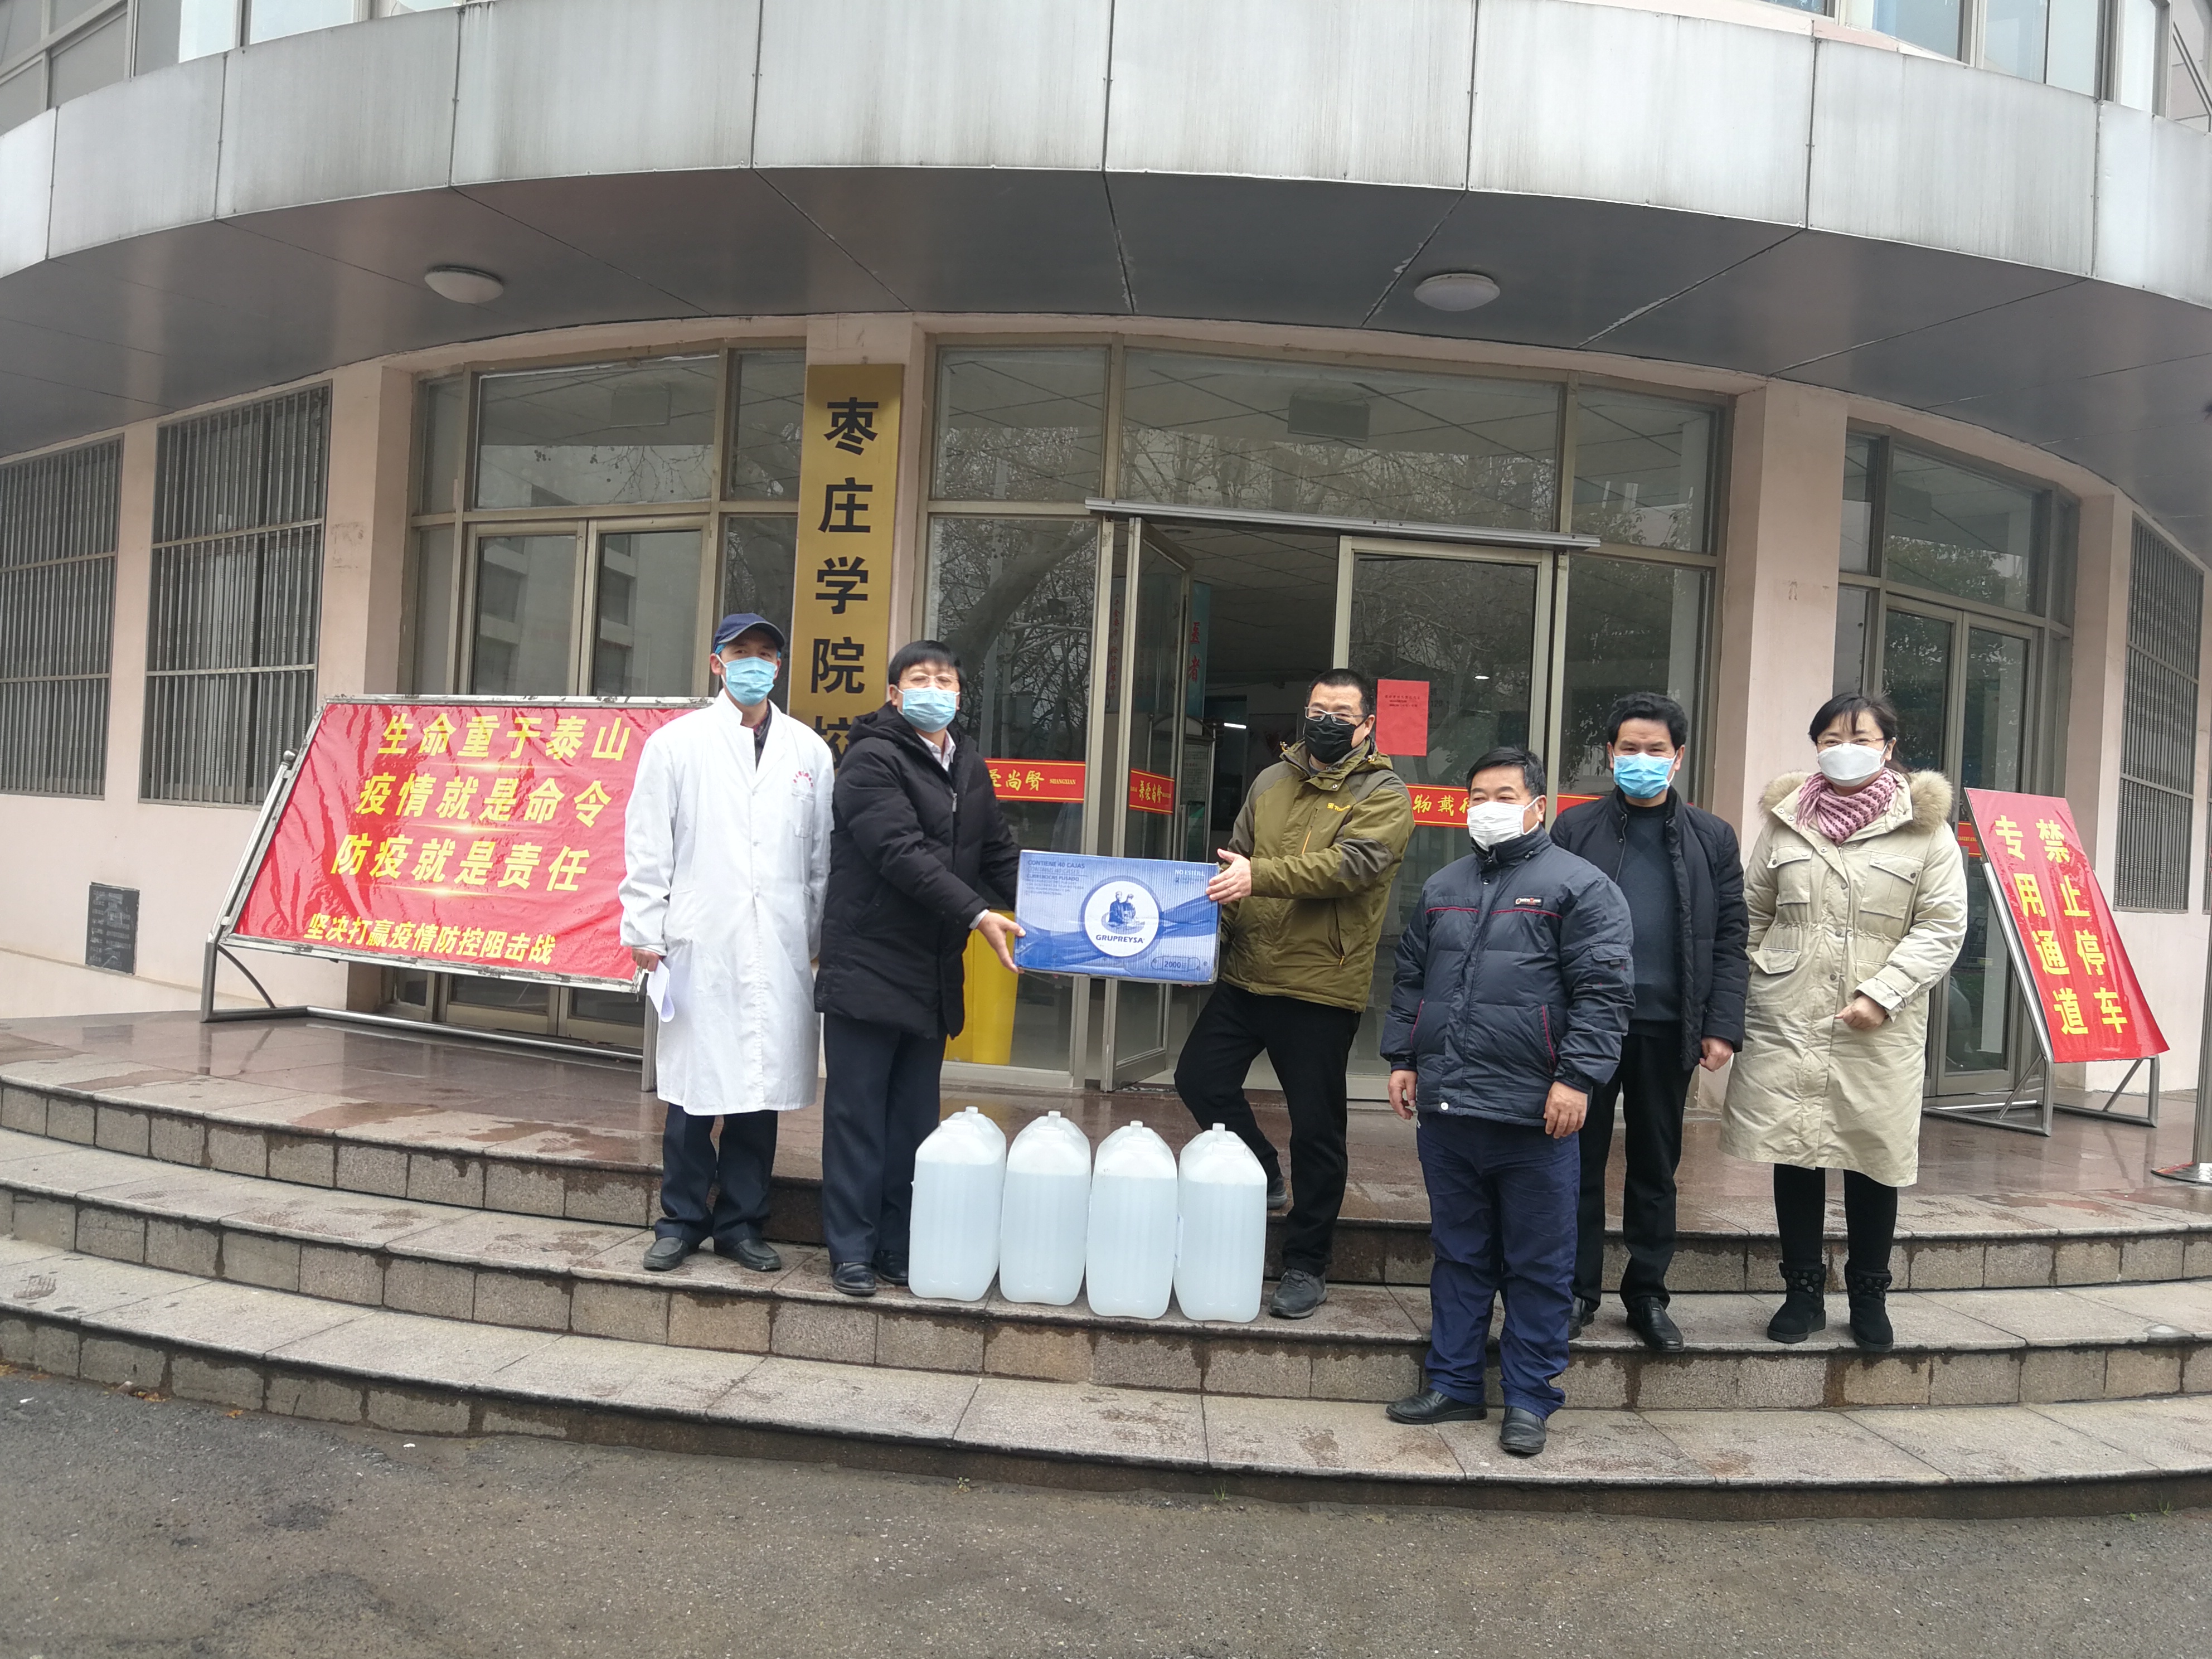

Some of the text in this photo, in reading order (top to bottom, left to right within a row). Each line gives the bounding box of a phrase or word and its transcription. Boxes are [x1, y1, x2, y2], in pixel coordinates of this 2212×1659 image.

[377, 712, 631, 761] 生命重于泰山
[355, 772, 612, 827] 疫情就是命令
[331, 834, 590, 892] 防疫就是责任
[303, 913, 556, 966] 坚决打赢疫情防控阻击战
[1095, 934, 1143, 944] GRUPREYSA
[1995, 814, 2089, 1035] 专用通道
[2035, 818, 2128, 1034] 禁止停车
